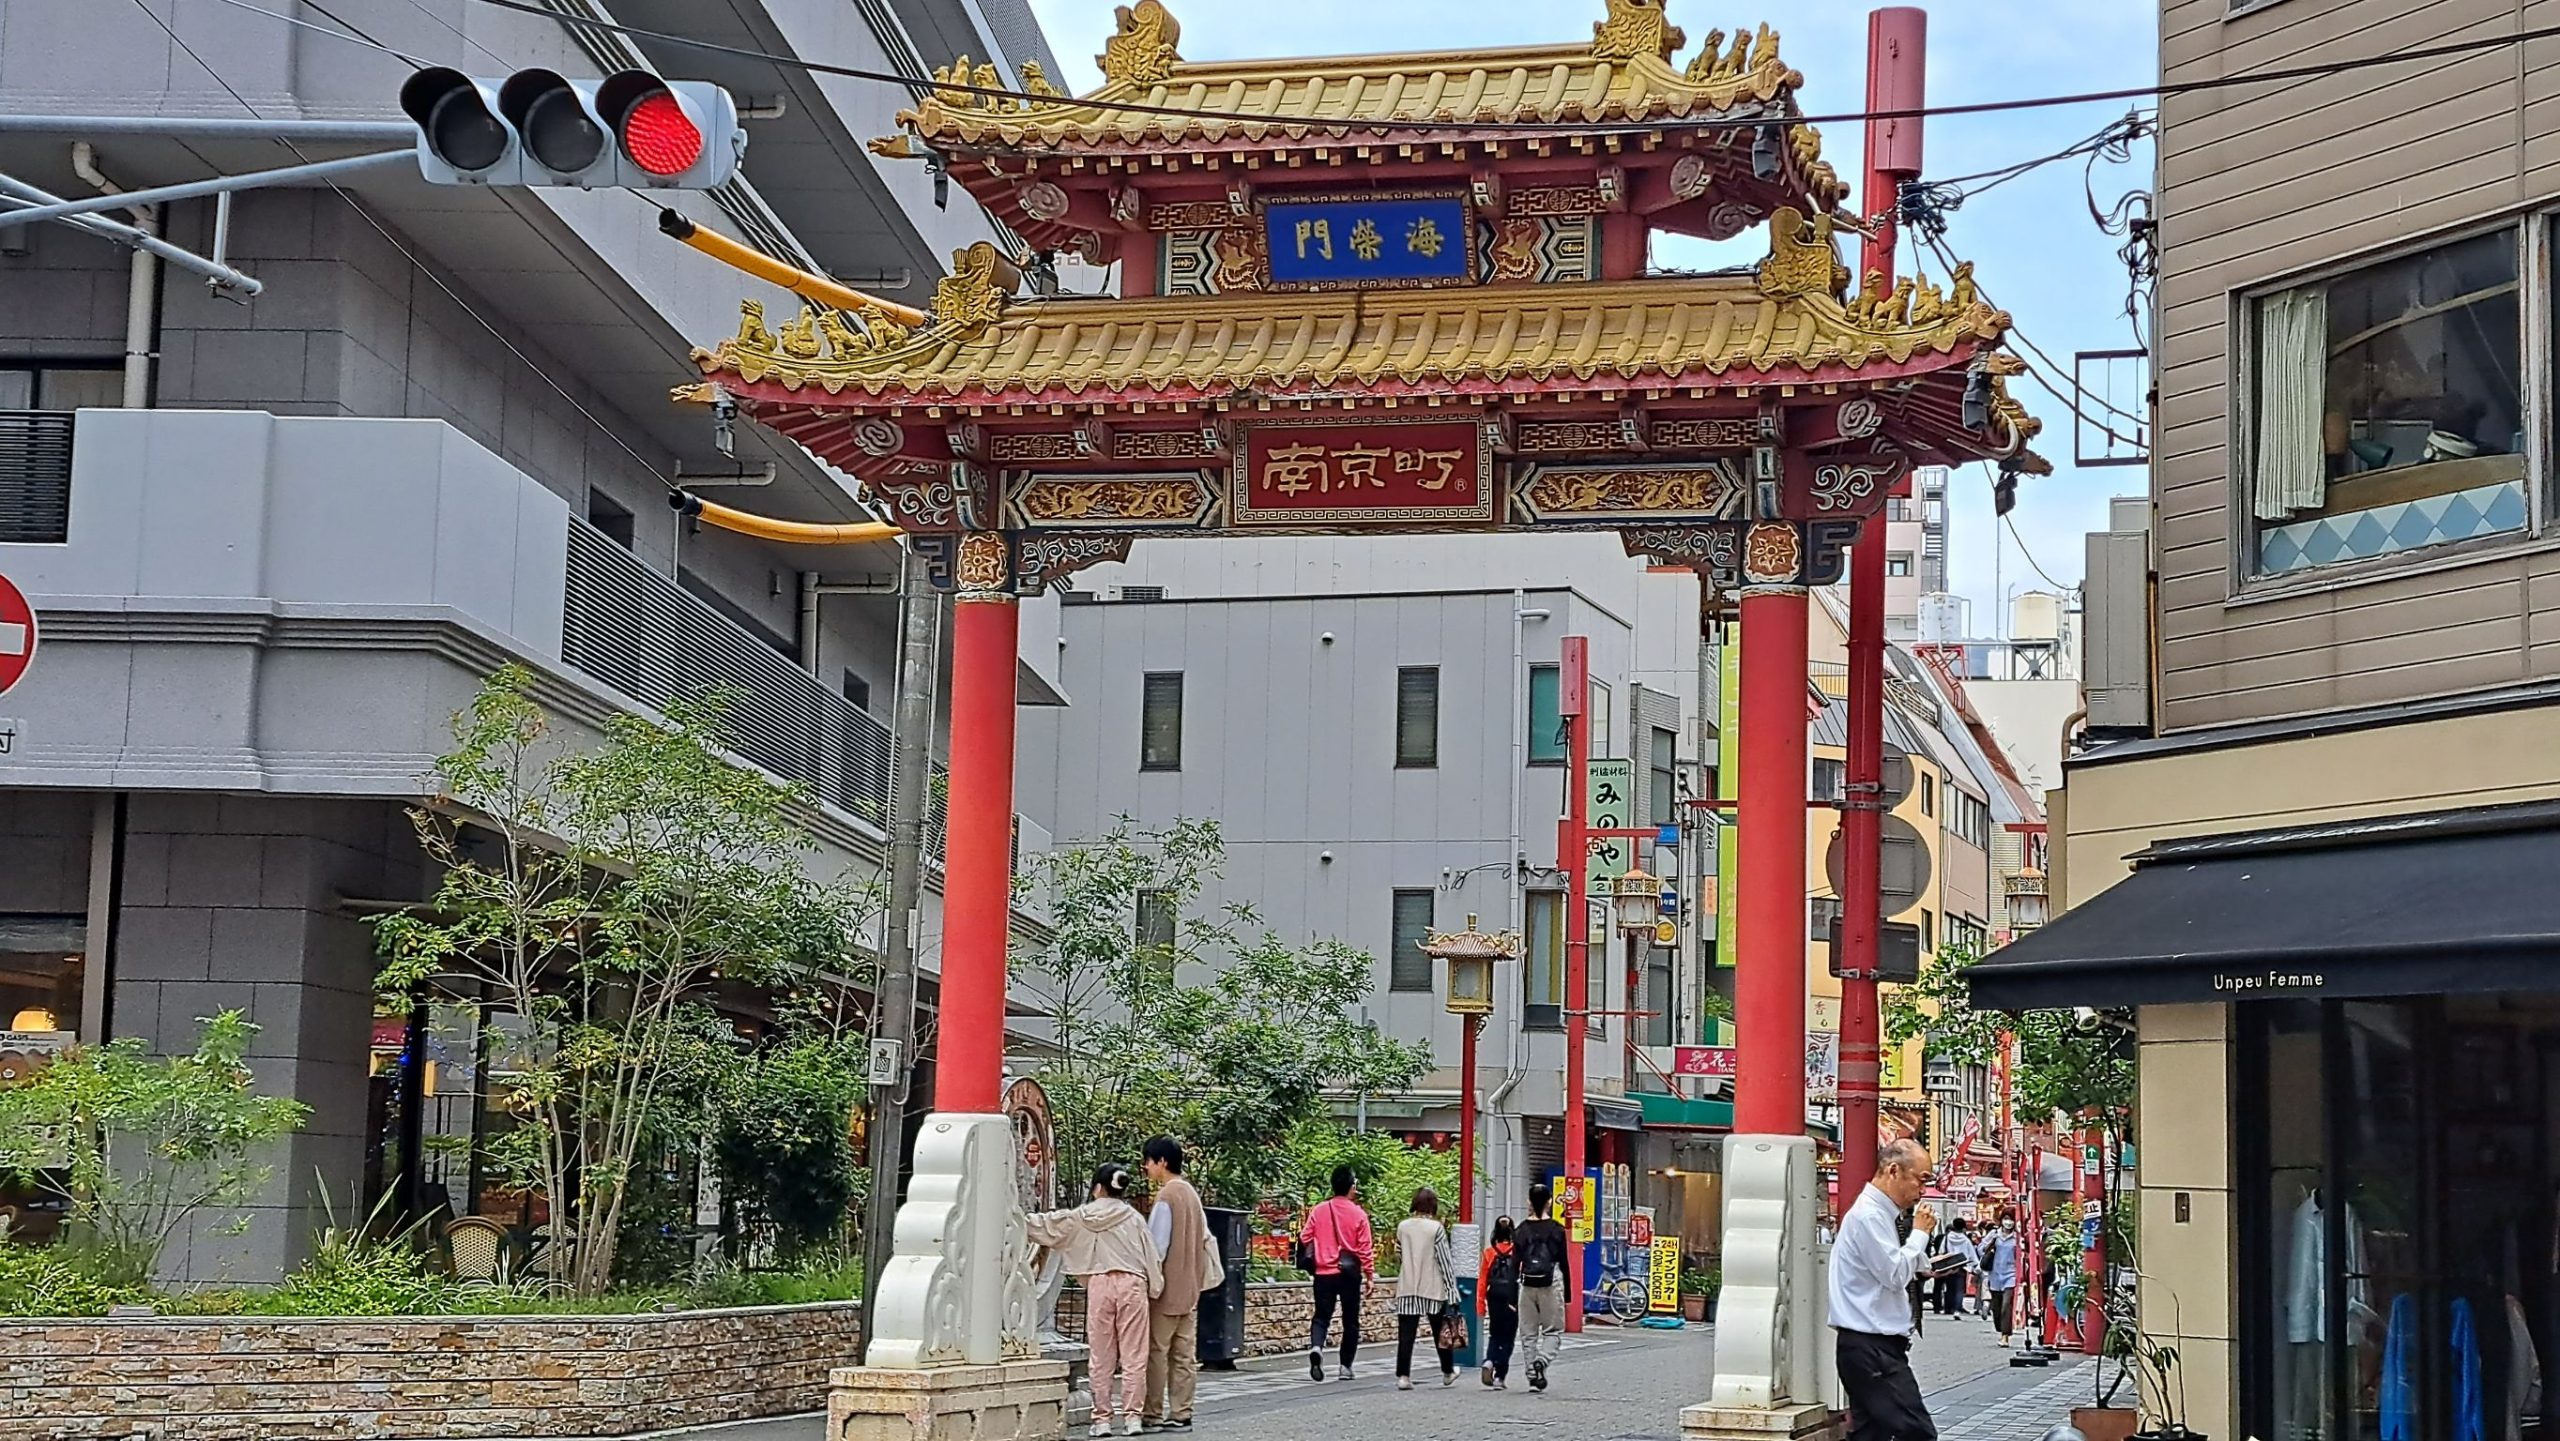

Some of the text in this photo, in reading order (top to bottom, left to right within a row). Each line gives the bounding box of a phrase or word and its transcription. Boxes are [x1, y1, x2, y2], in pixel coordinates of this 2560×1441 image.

[1262, 441, 1464, 498] 南京町
[1595, 782, 1622, 867] みのや
[2214, 971, 2323, 994] Unpeu Femme
[1663, 1250, 1677, 1301] コインロッカー
